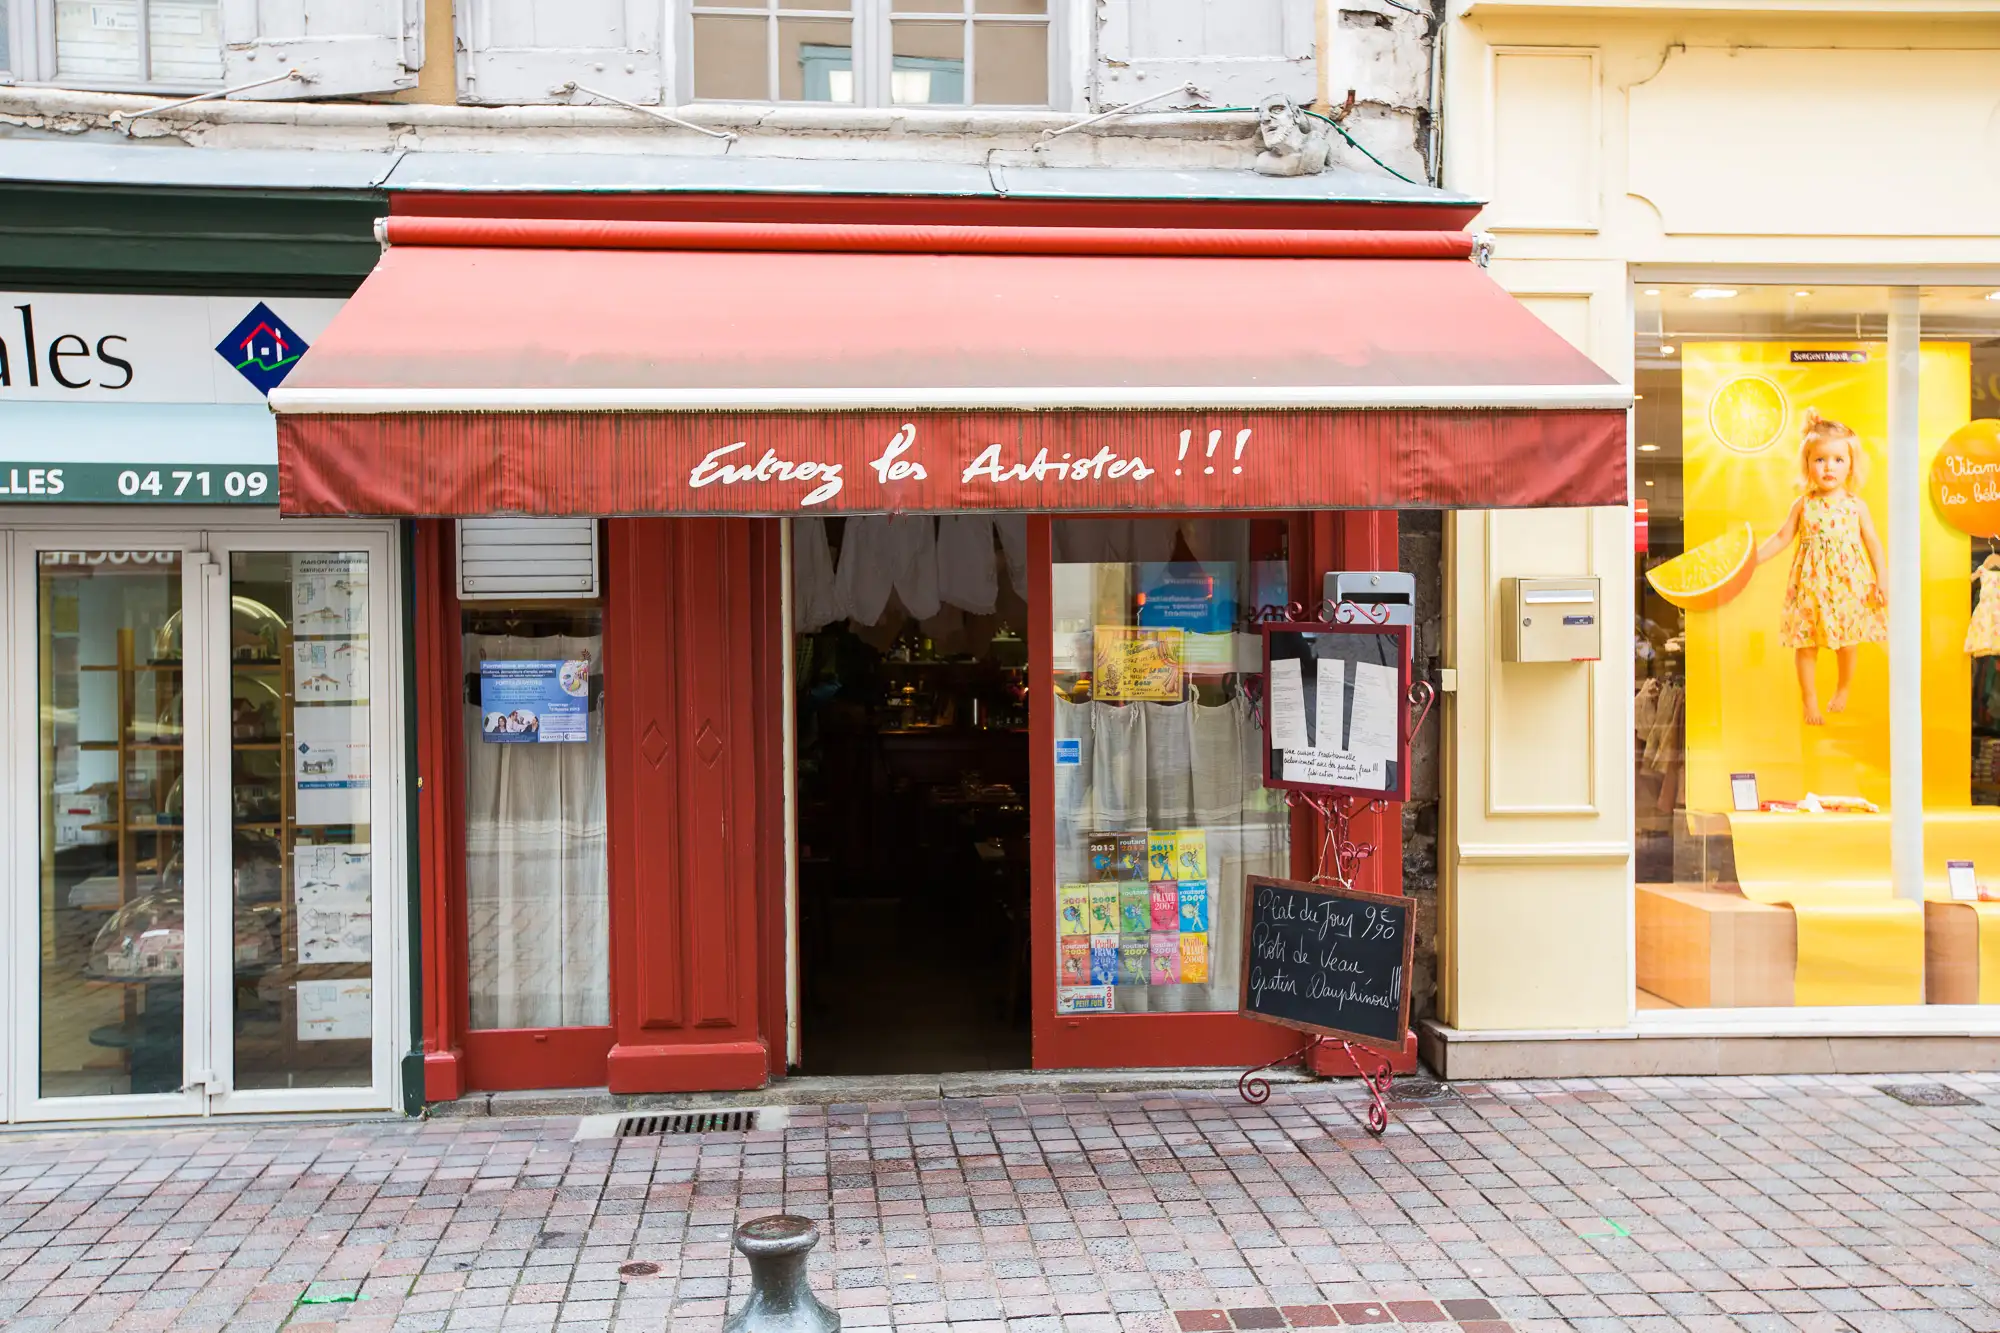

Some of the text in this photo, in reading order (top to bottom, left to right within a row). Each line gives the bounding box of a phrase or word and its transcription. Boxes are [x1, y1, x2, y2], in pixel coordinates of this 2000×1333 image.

[689, 441, 844, 507] Entrez
[868, 422, 928, 484] les
[961, 443, 1155, 484] Artistes
[1945, 455, 2000, 477] Vitam
[117, 470, 163, 496] 04
[171, 471, 210, 496] 71
[224, 471, 268, 497] 09
[1941, 480, 2000, 505] les béb
[1090, 844, 1115, 852] 2013
[1150, 844, 1174, 852] 2011
[1092, 896, 1117, 904] 2005
[1180, 894, 1205, 902] 2009
[1154, 902, 1175, 911] 2007
[1258, 888, 1296, 921] Plat
[1299, 897, 1320, 924] du
[1318, 900, 1353, 941] Jour
[1124, 948, 1148, 956] 2007
[1292, 934, 1311, 965] de
[1320, 941, 1365, 974] Veau
